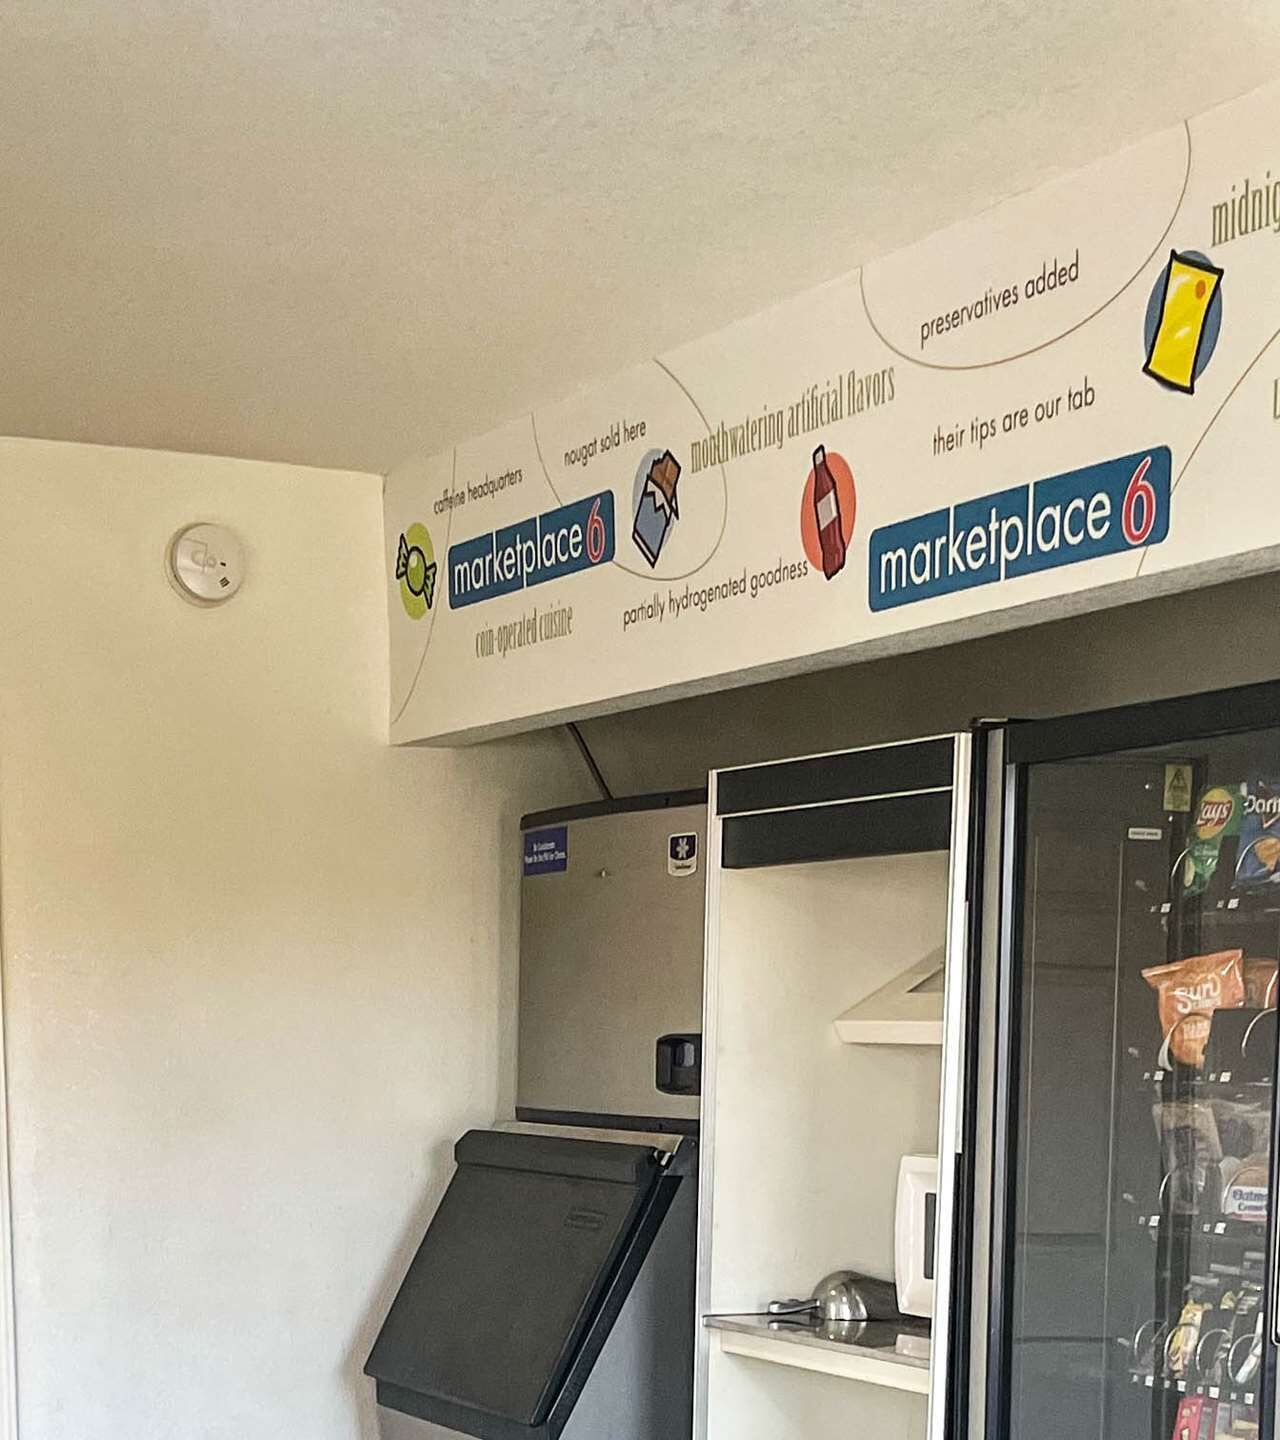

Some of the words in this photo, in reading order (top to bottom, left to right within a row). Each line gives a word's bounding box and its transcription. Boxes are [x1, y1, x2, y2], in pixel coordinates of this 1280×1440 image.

[920, 283, 1019, 349] preservatives
[1024, 250, 1080, 301] added
[564, 437, 597, 466] nougat
[600, 428, 620, 451] sold
[620, 418, 646, 445] here
[690, 404, 785, 475] mouthwatering
[786, 386, 844, 438] artificial
[847, 365, 896, 413] flavors
[932, 420, 965, 456] their
[969, 413, 998, 452] tips
[1002, 405, 1030, 430] are
[1034, 398, 1063, 425] our
[1067, 383, 1096, 413] tab
[433, 481, 466, 515] caffeine
[467, 467, 524, 506] headquarters
[879, 483, 1112, 593] marketplace
[1121, 456, 1157, 545] 6
[454, 515, 583, 593] marketplace
[585, 497, 606, 564] 6
[475, 614, 538, 659] coin-operated
[539, 603, 574, 649] cuisine
[623, 598, 666, 632] partially
[667, 577, 748, 616] hydrogenated
[750, 559, 809, 597] goodness
